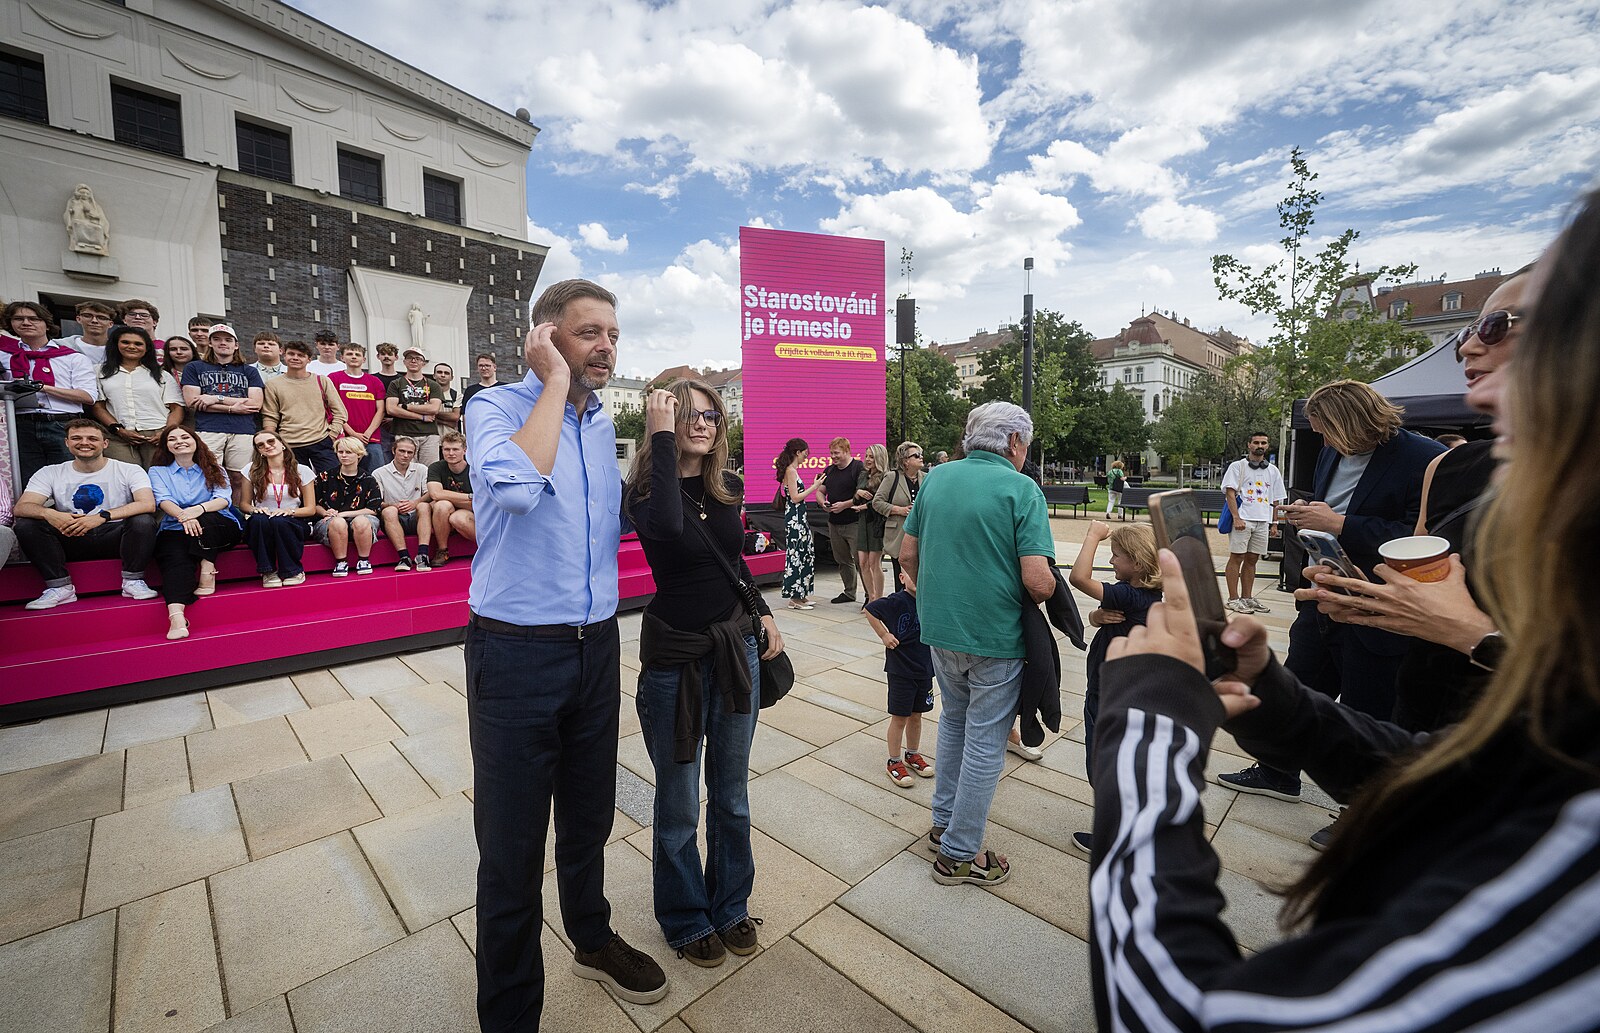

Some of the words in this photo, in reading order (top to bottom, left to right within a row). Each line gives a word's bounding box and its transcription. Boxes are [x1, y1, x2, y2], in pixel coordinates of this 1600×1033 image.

[744, 284, 877, 316] Starostování
[744, 311, 765, 341] je
[768, 311, 852, 340] řemeslo
[779, 347, 803, 357] Přijďte
[809, 348, 834, 356] volbám
[856, 350, 872, 360] října
